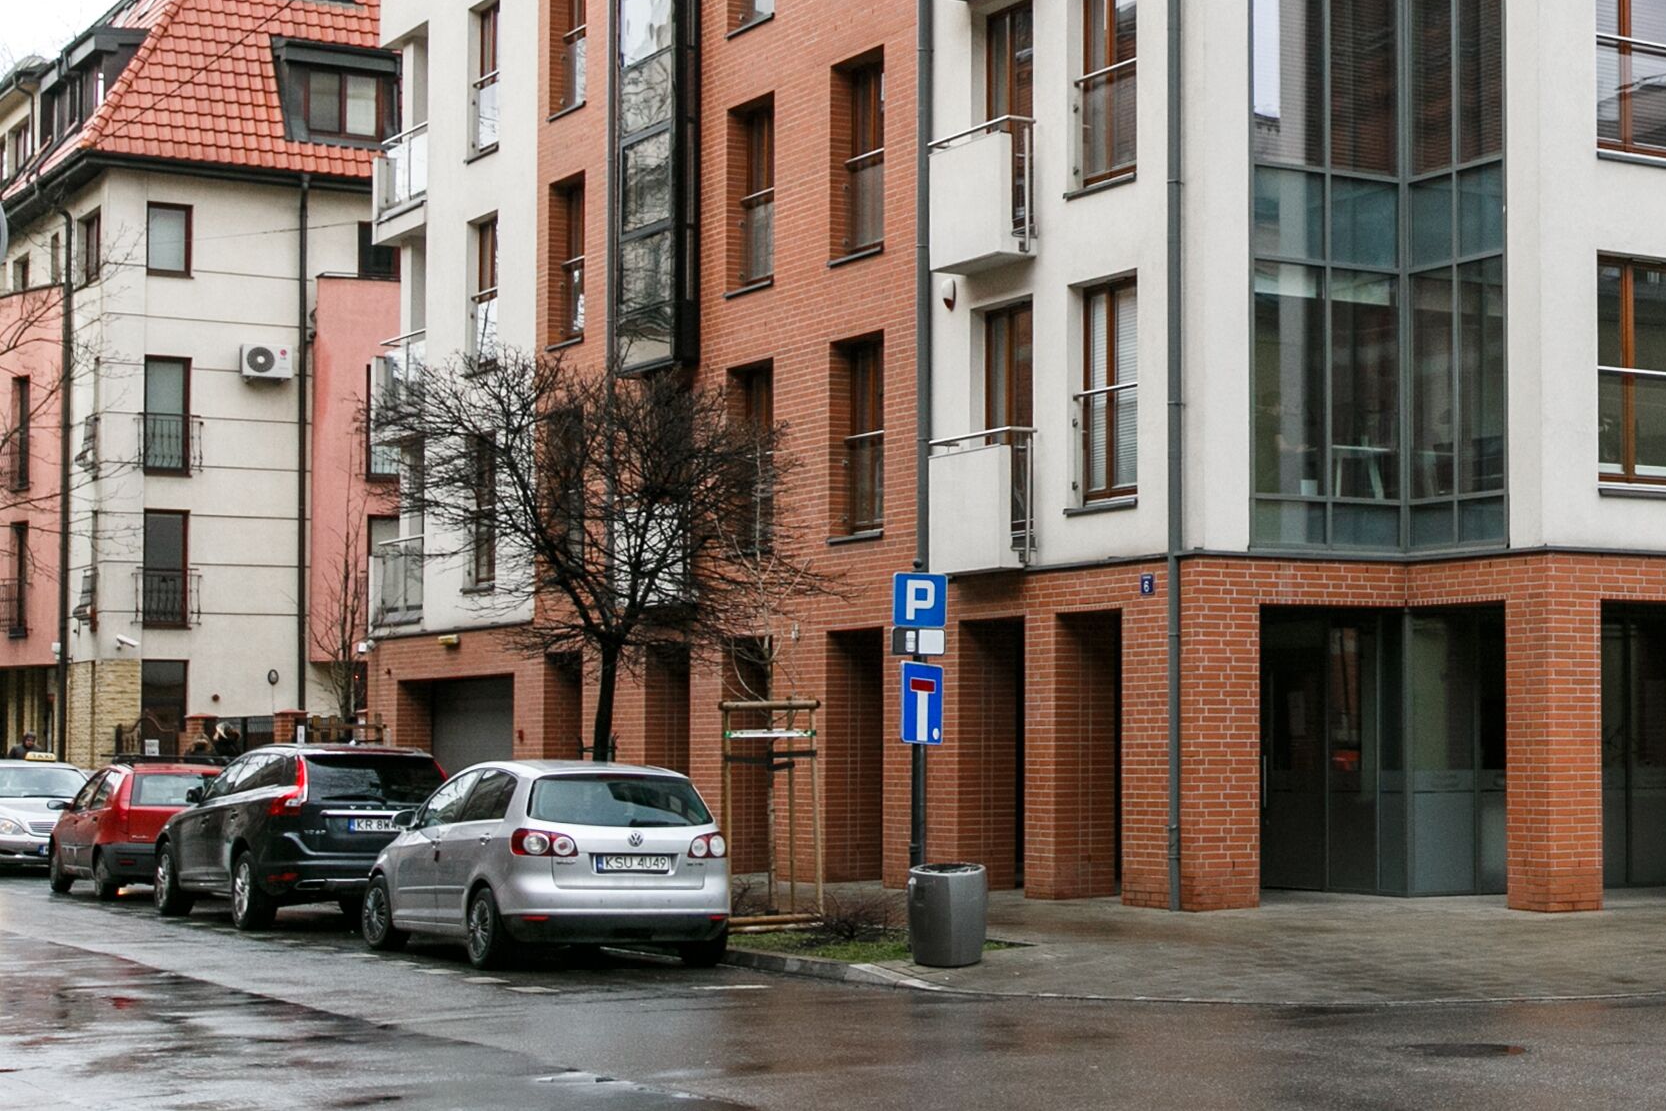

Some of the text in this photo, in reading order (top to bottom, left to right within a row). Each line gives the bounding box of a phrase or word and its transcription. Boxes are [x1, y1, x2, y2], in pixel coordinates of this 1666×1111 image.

[1143, 581, 1150, 592] 6
[906, 579, 935, 620] P
[356, 819, 373, 830] KR
[605, 856, 667, 870] KSU 4U49
